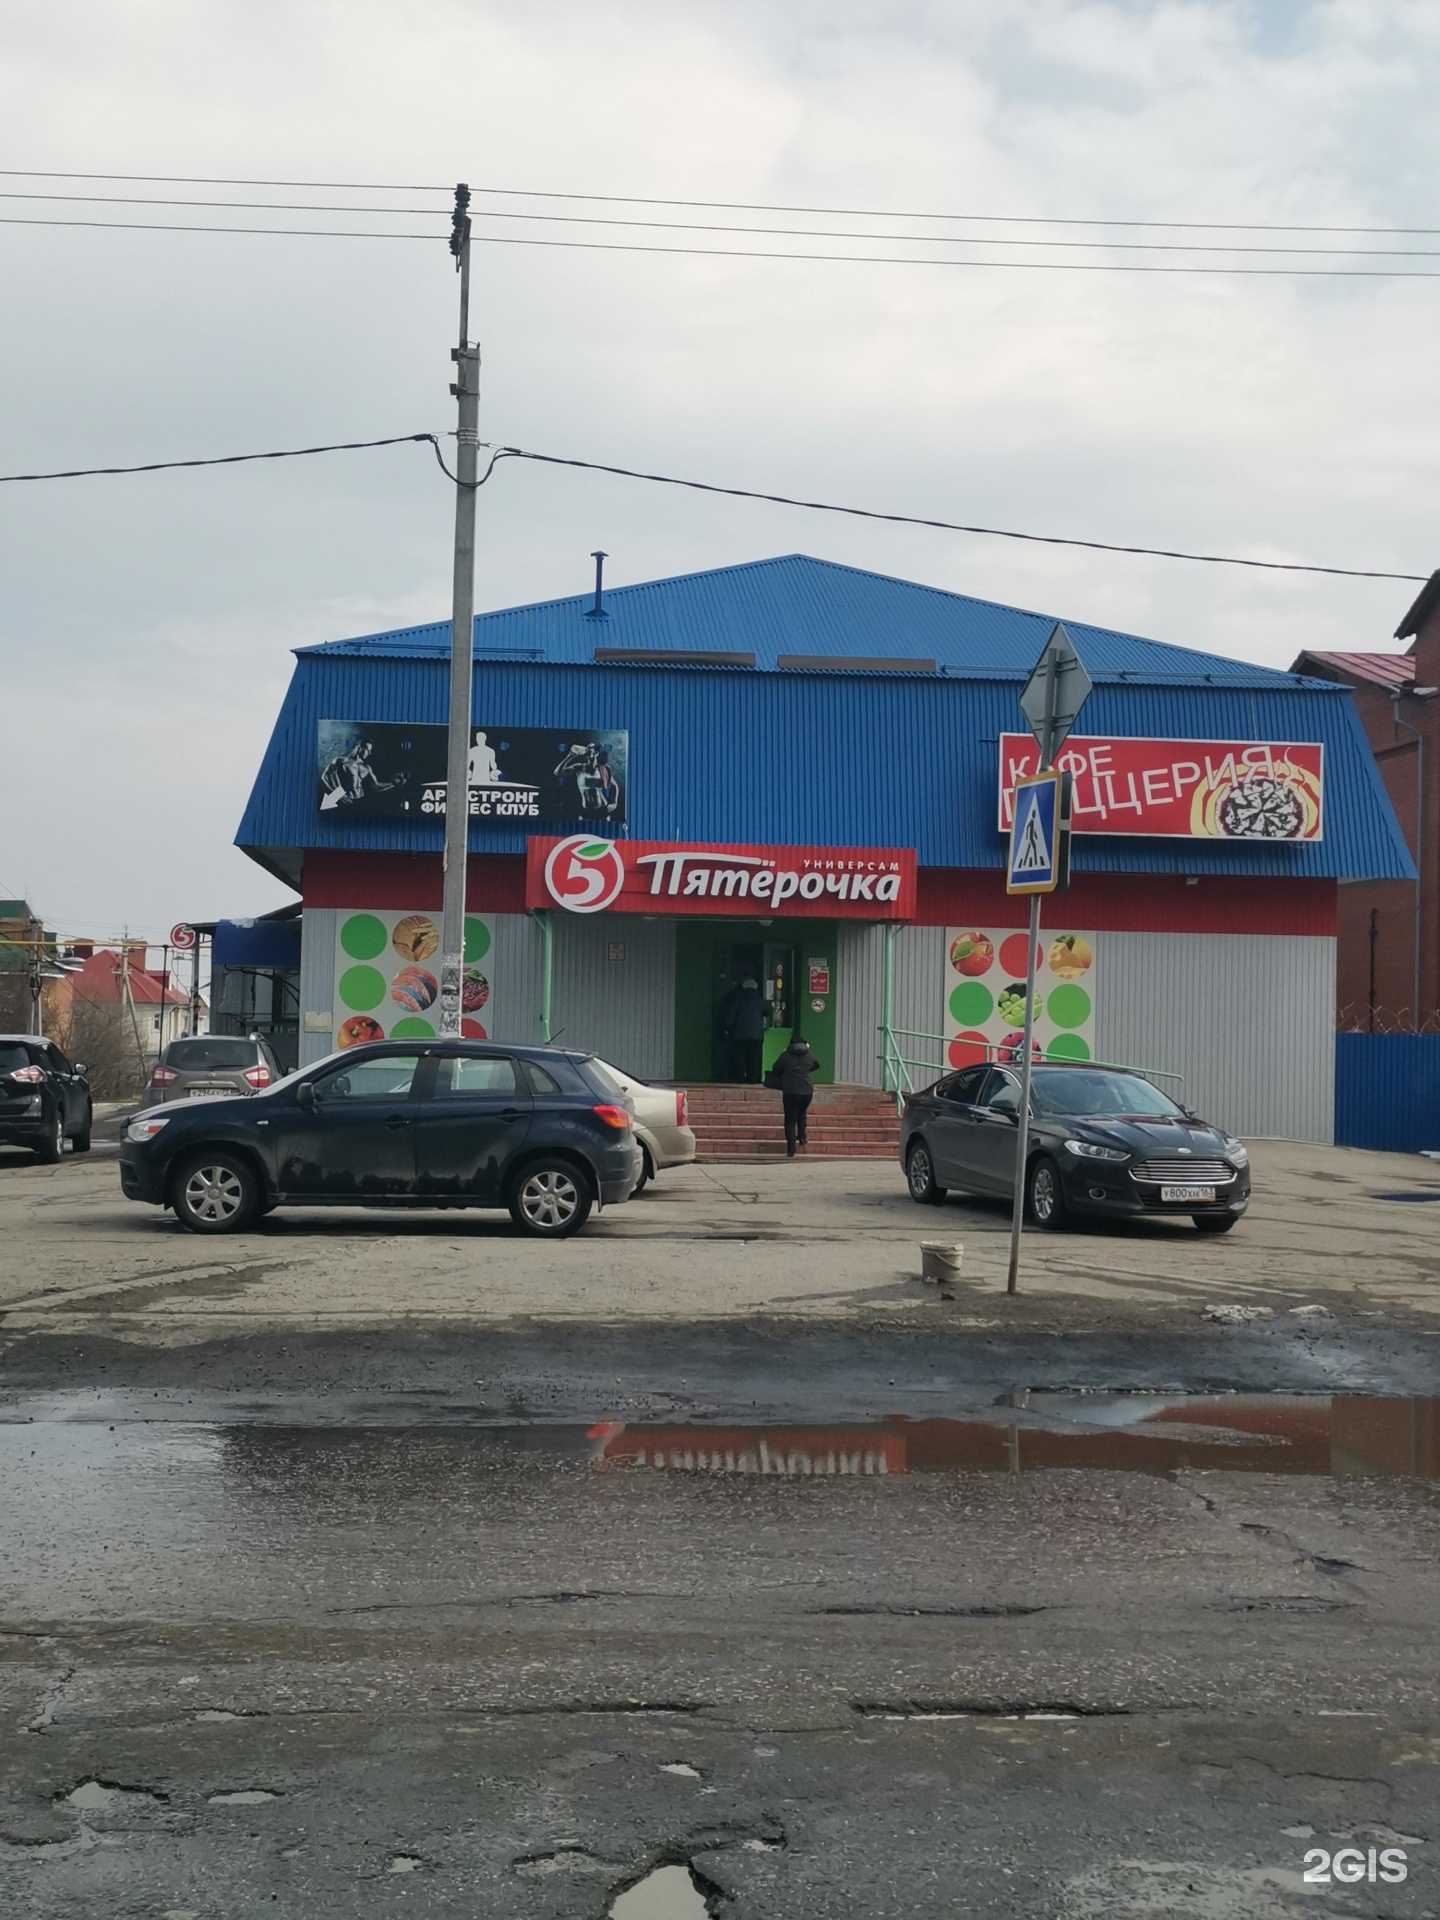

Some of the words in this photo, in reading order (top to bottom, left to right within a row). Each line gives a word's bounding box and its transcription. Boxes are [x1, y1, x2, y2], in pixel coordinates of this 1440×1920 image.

[1008, 745, 1116, 787] КФЕ
[421, 789, 539, 804] АРСТРОНГ
[1003, 745, 1275, 822] ЦЦЕРИЯ
[421, 801, 491, 815] ФИЕС
[496, 803, 539, 816] КЛУБ
[803, 859, 900, 872] УНИВЕРСАМ
[636, 852, 901, 908] Пятёрочка
